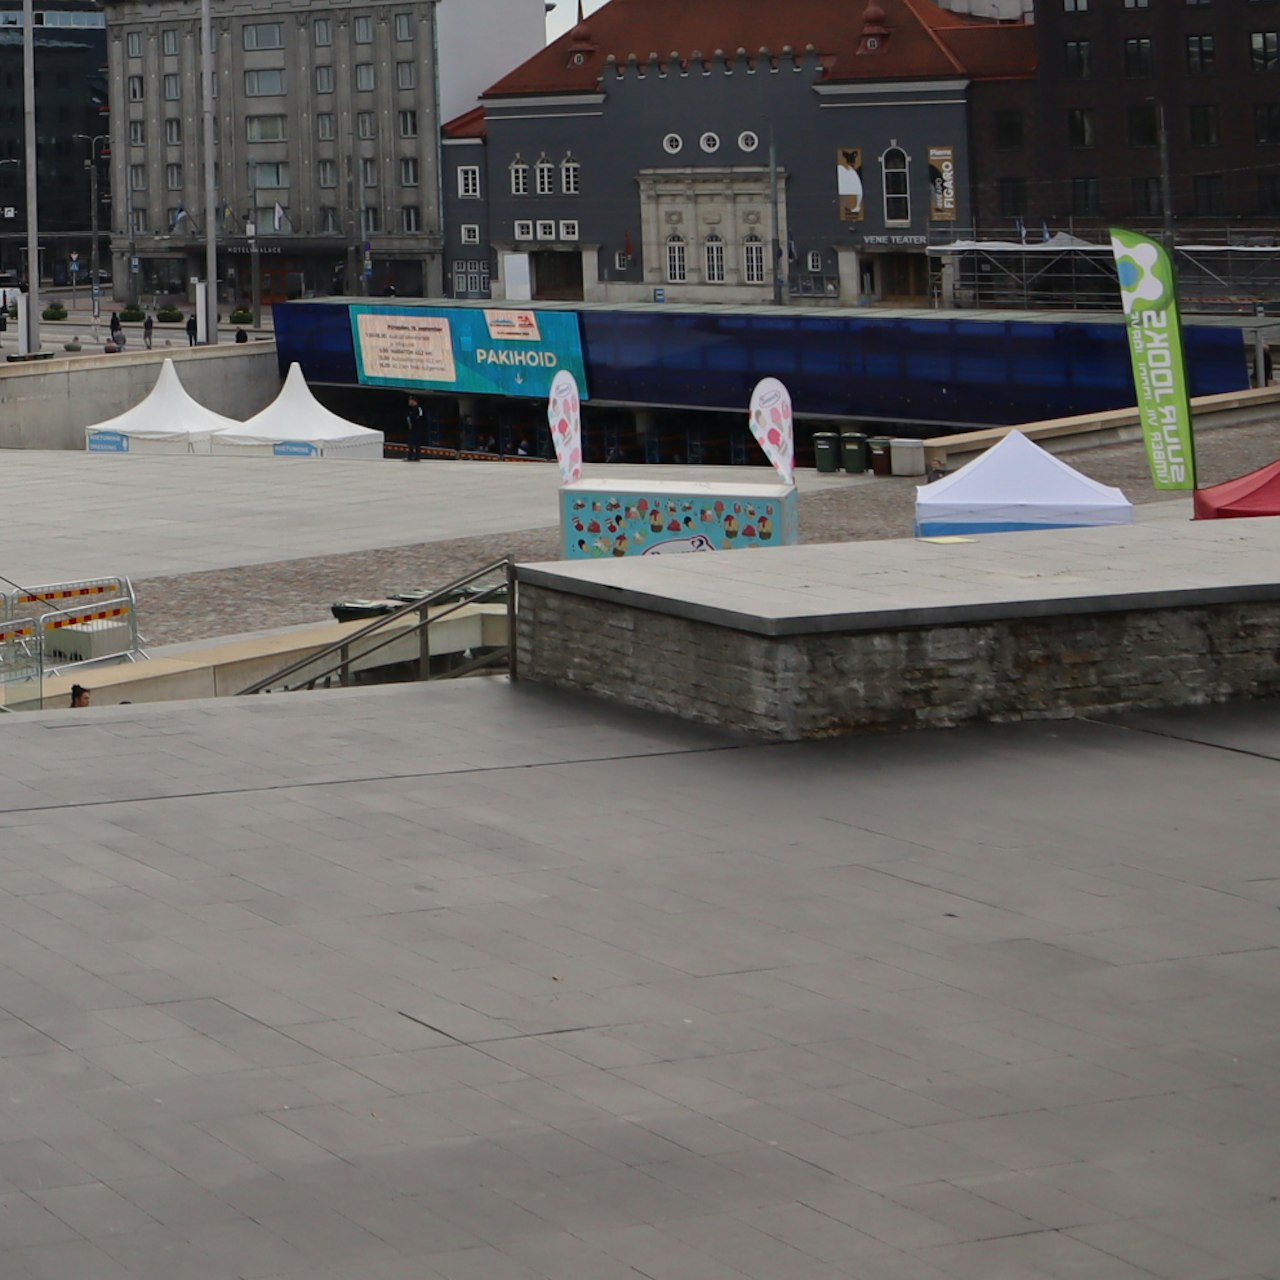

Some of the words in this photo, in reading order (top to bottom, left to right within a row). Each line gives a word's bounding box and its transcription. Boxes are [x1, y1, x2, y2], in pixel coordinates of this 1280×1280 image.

[942, 161, 954, 208] FIGARO
[864, 236, 889, 244] VENE
[891, 235, 927, 244] TEATER
[476, 348, 557, 367] PAKIHOID
